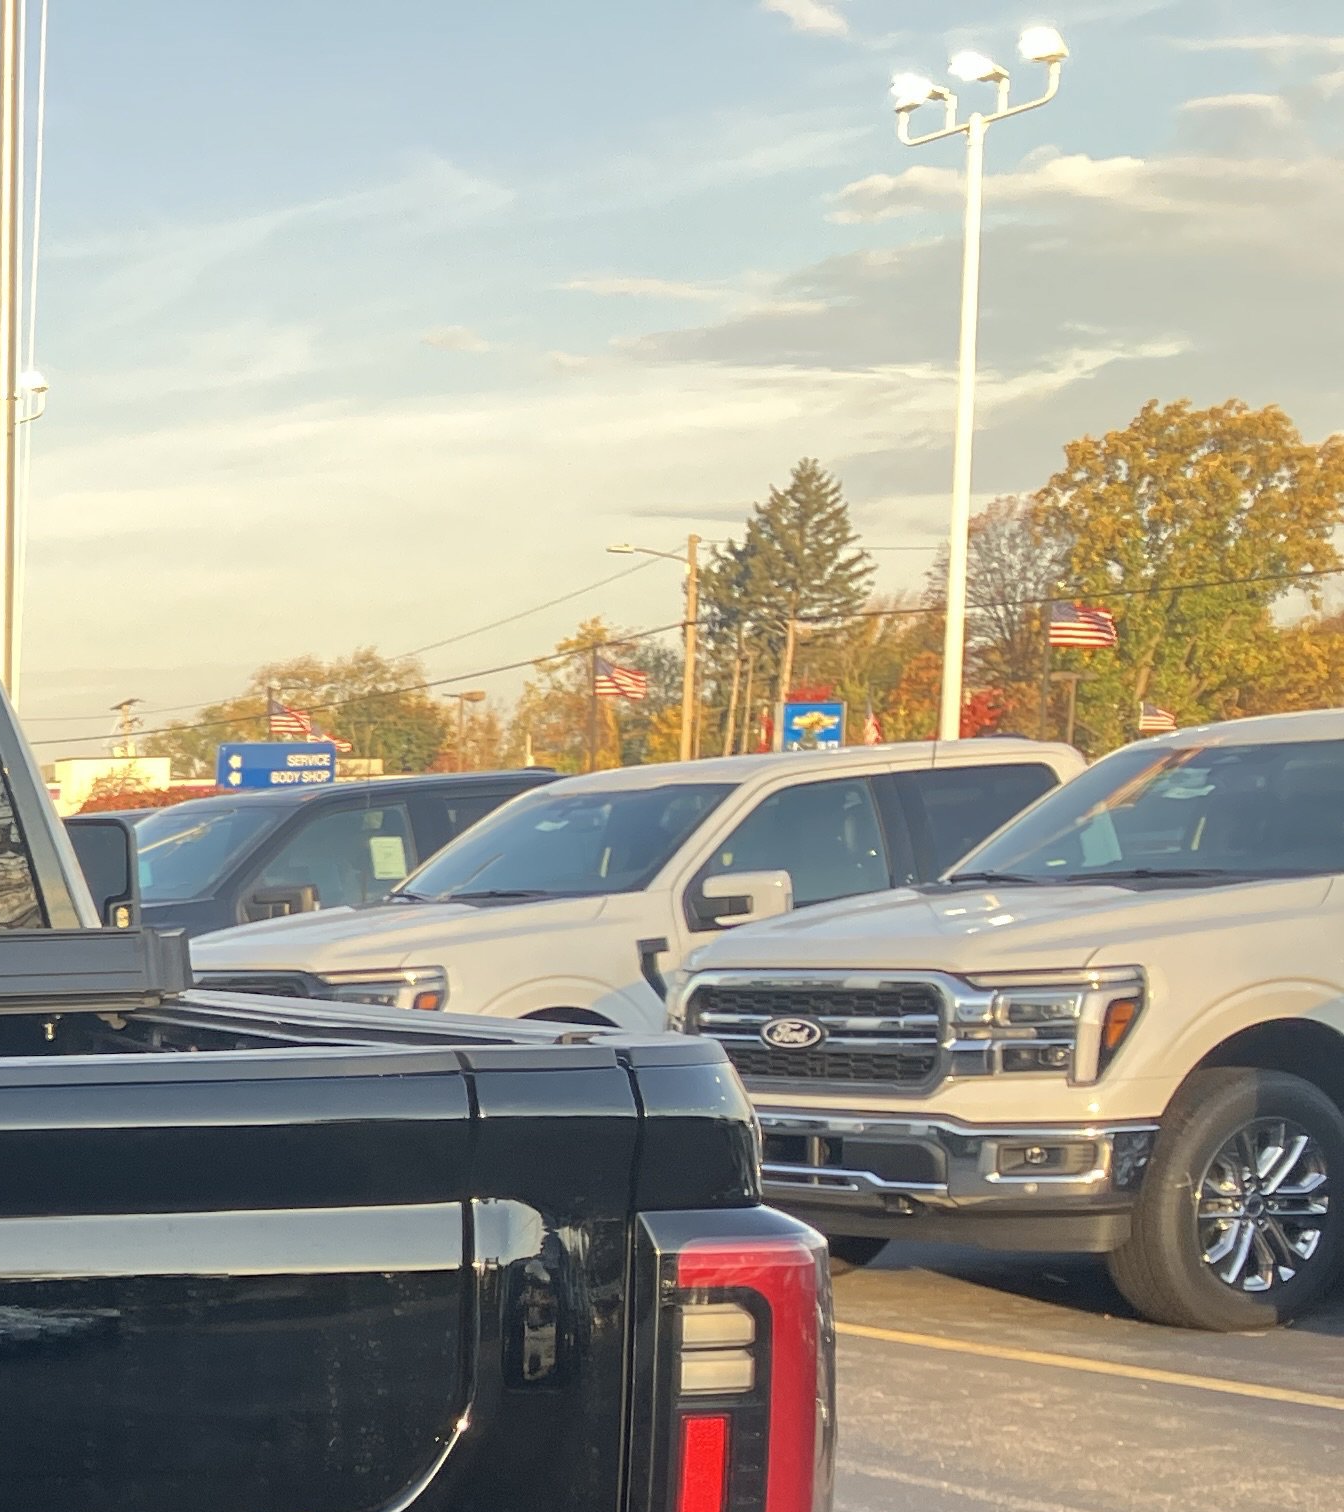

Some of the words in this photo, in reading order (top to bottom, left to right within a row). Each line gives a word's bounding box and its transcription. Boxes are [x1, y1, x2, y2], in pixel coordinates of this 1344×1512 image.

[286, 753, 331, 768] SERVICE
[270, 771, 300, 784] BODY
[302, 770, 331, 783] SHOP
[772, 1022, 811, 1044] Ford
